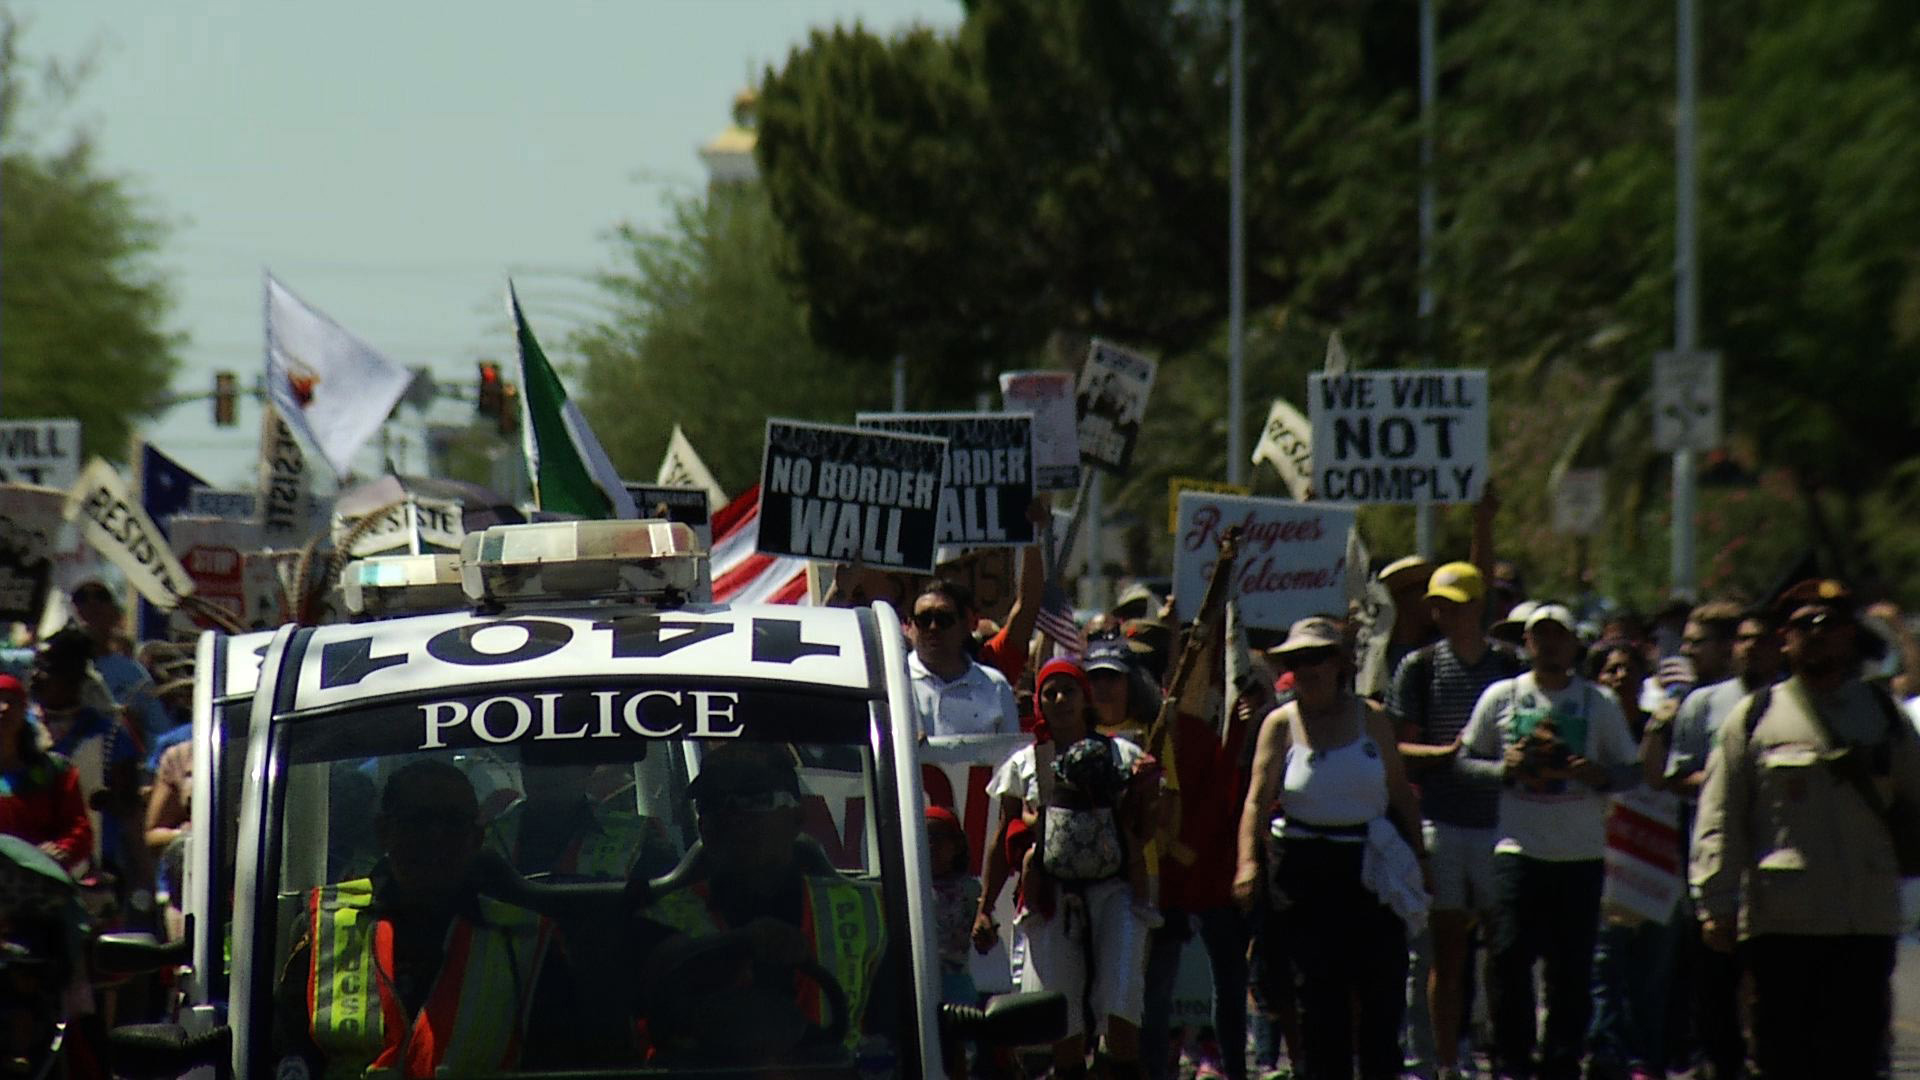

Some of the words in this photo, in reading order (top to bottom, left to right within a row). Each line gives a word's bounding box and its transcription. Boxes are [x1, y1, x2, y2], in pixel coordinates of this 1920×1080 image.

[1321, 377, 1375, 409] WE
[1391, 376, 1472, 409] WILL
[1333, 416, 1461, 460] NOT
[770, 456, 812, 496] NO
[818, 461, 935, 511] BORDER
[1324, 463, 1474, 501] COMPLY
[790, 496, 904, 566] WALL
[1184, 504, 1324, 553] Rfugees
[418, 690, 744, 749] POLICE
